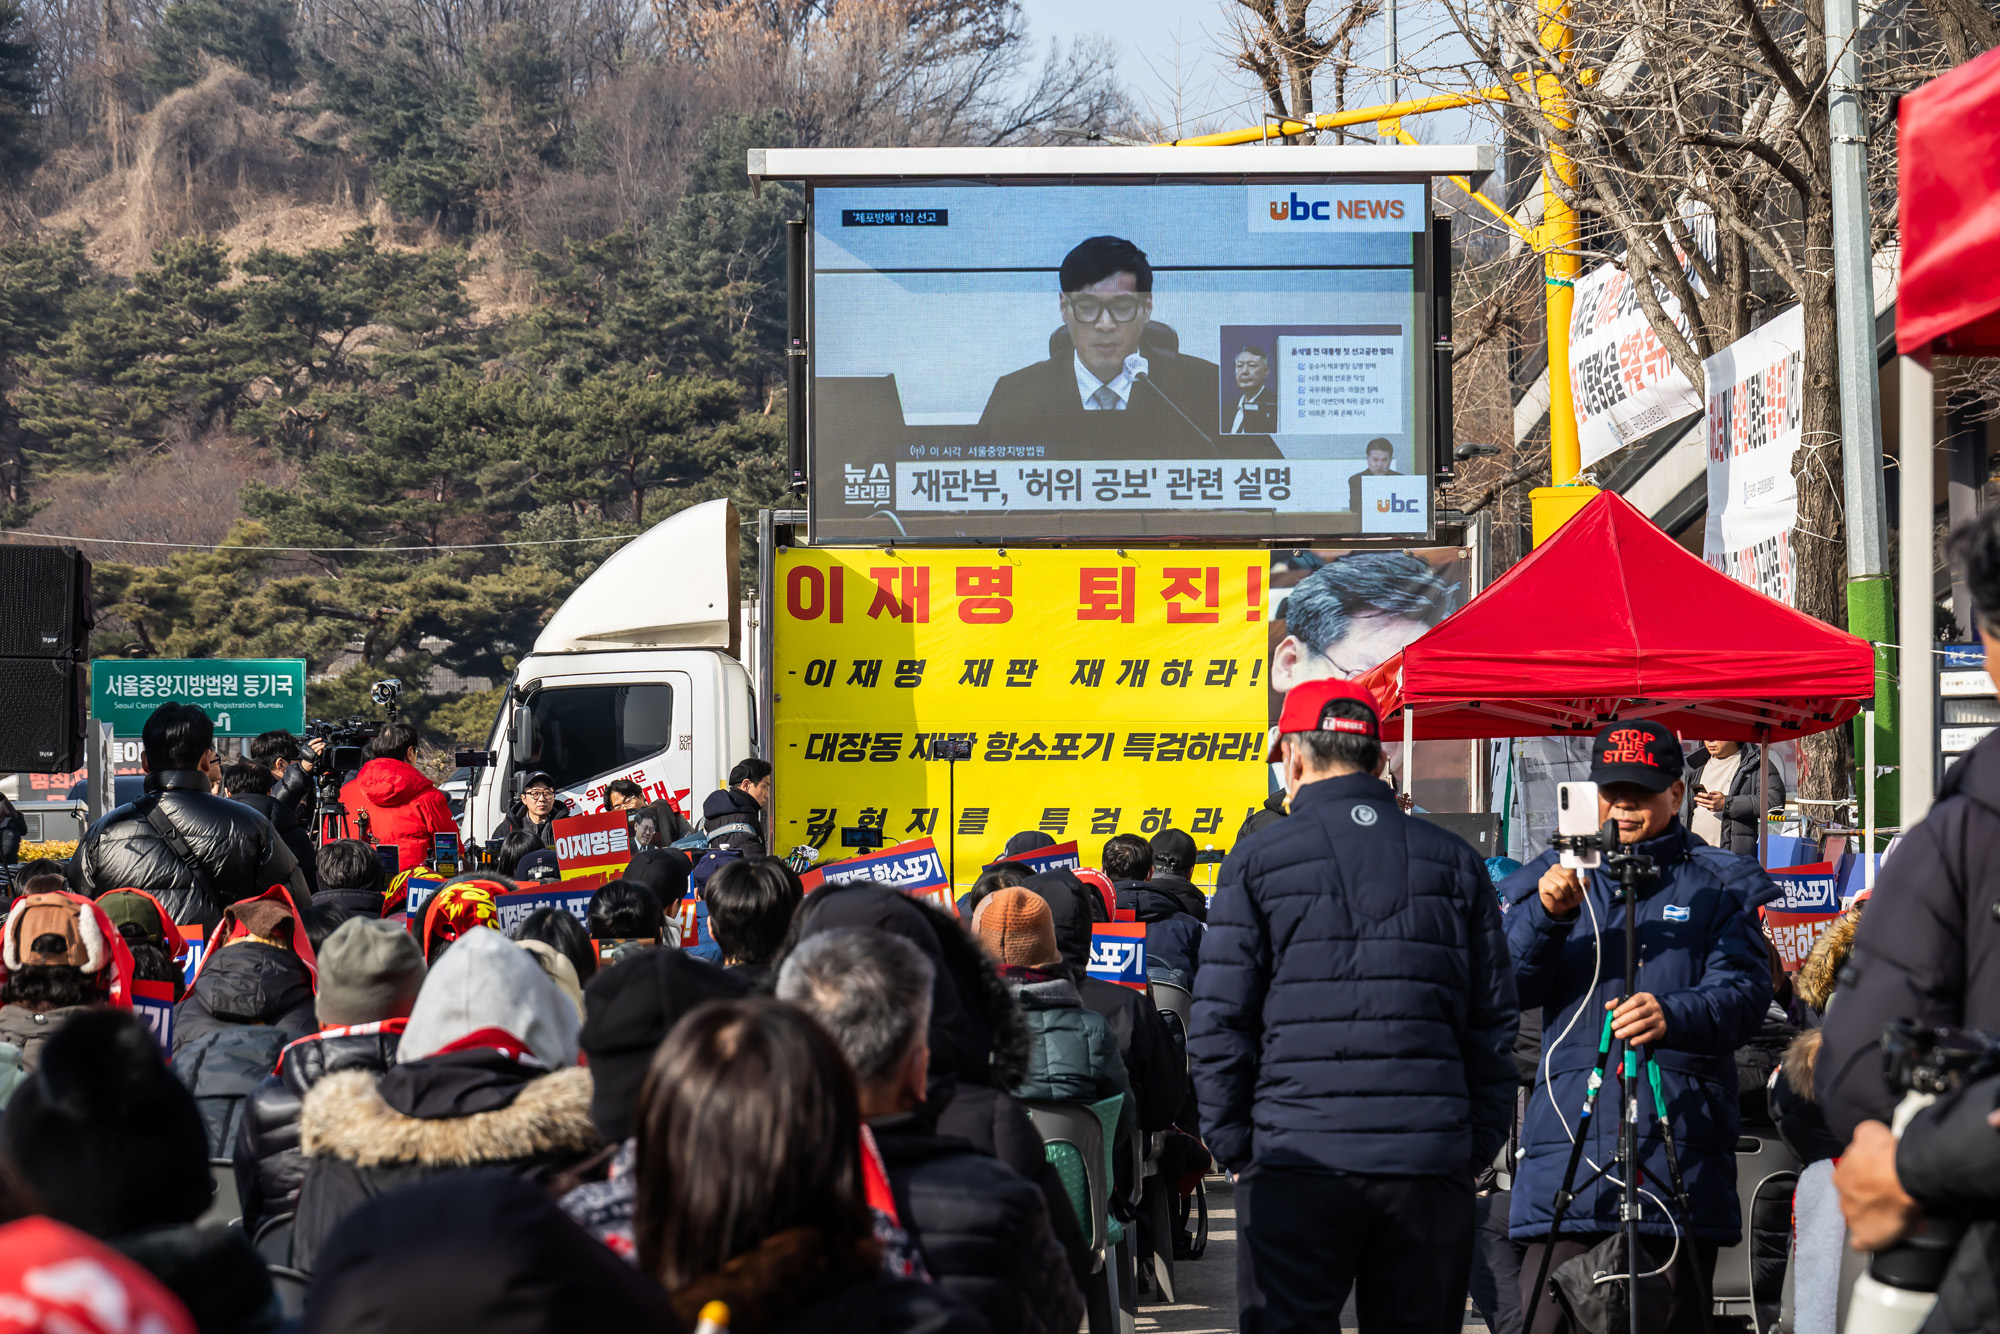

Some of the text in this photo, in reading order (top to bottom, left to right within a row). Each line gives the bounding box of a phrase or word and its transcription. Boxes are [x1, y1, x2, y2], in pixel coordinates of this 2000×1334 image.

[1270, 192, 1405, 221] ubc NEWS
[852, 212, 937, 224] '체포방해' 1심 선고
[930, 445, 1046, 457] 이 시각 서울중앙지방법원
[845, 463, 890, 484] 뉴스
[845, 485, 890, 499] 브리핑
[911, 467, 1291, 506] 재판부, '허위 공보' 관련 설명
[1377, 493, 1420, 513] ubc
[786, 565, 1262, 624] 이재명 퇴진!
[958, 659, 1039, 688] 재판
[1069, 658, 1264, 688] 재개하라!
[105, 674, 293, 697] 서울중앙지방법원 등기국
[213, 702, 256, 711] Registration
[679, 735, 691, 743] CCP
[1608, 729, 1656, 744] STOP
[1615, 741, 1645, 750] THE
[985, 732, 1115, 762] 항소포기
[1123, 732, 1265, 762] 특검하라!
[1602, 750, 1659, 767] STEAL
[556, 828, 629, 860] 이재명을
